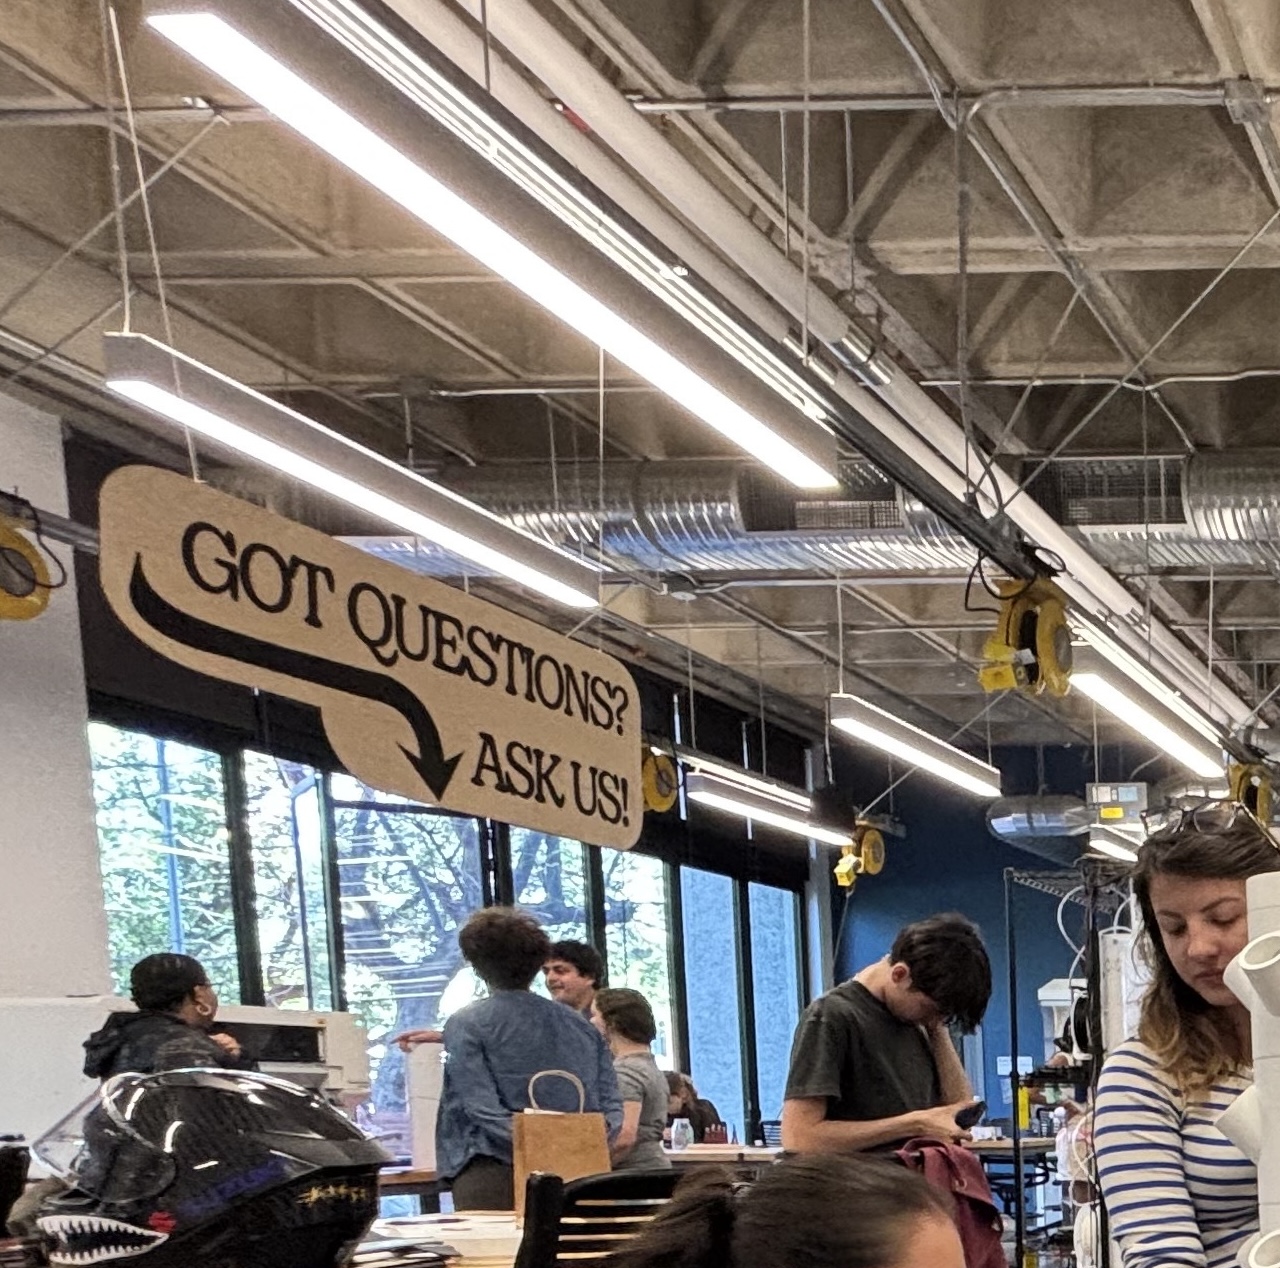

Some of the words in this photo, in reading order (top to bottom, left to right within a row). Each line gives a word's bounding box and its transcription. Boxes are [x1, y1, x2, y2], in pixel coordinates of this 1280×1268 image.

[181, 521, 334, 628] GOT
[348, 582, 629, 736] QUESTIONS?
[471, 732, 565, 808] ASK
[572, 767, 631, 827] US!
